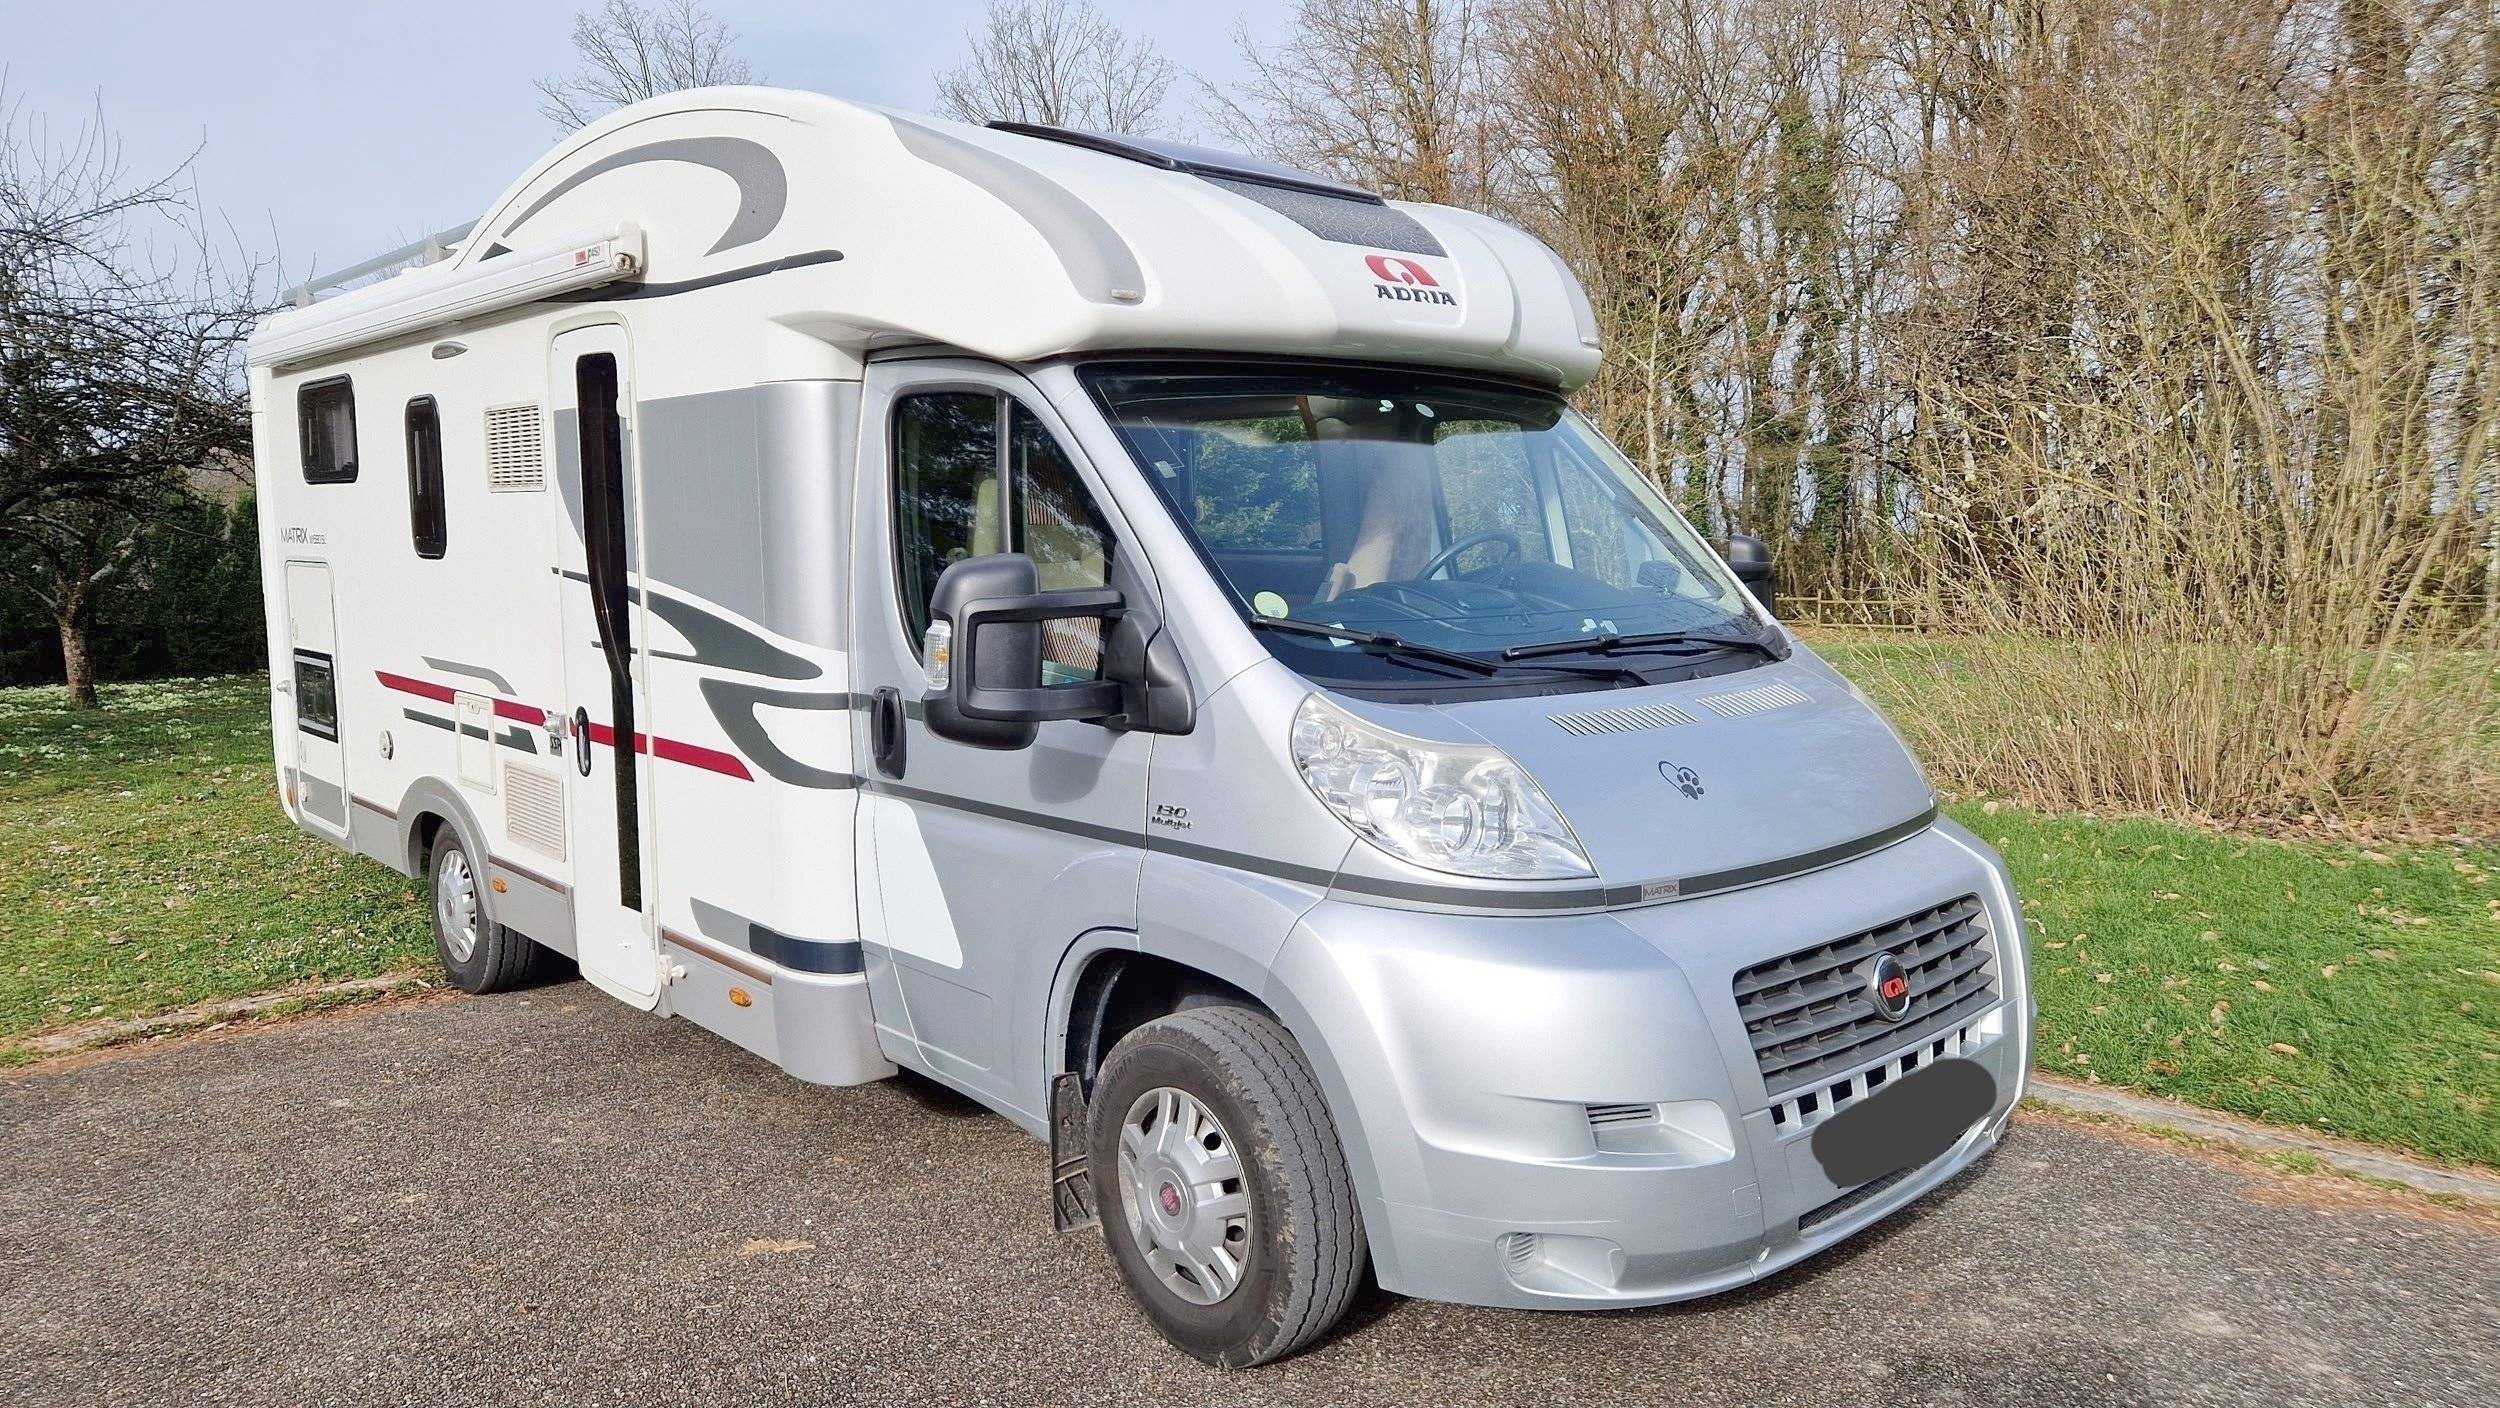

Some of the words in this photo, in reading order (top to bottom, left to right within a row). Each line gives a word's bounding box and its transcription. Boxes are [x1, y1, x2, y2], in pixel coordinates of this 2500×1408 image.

[1373, 284, 1458, 306] ADRIA
[280, 527, 309, 544] MATRIX
[1156, 804, 1187, 819] 130
[1644, 883, 1678, 897] MATRIX
